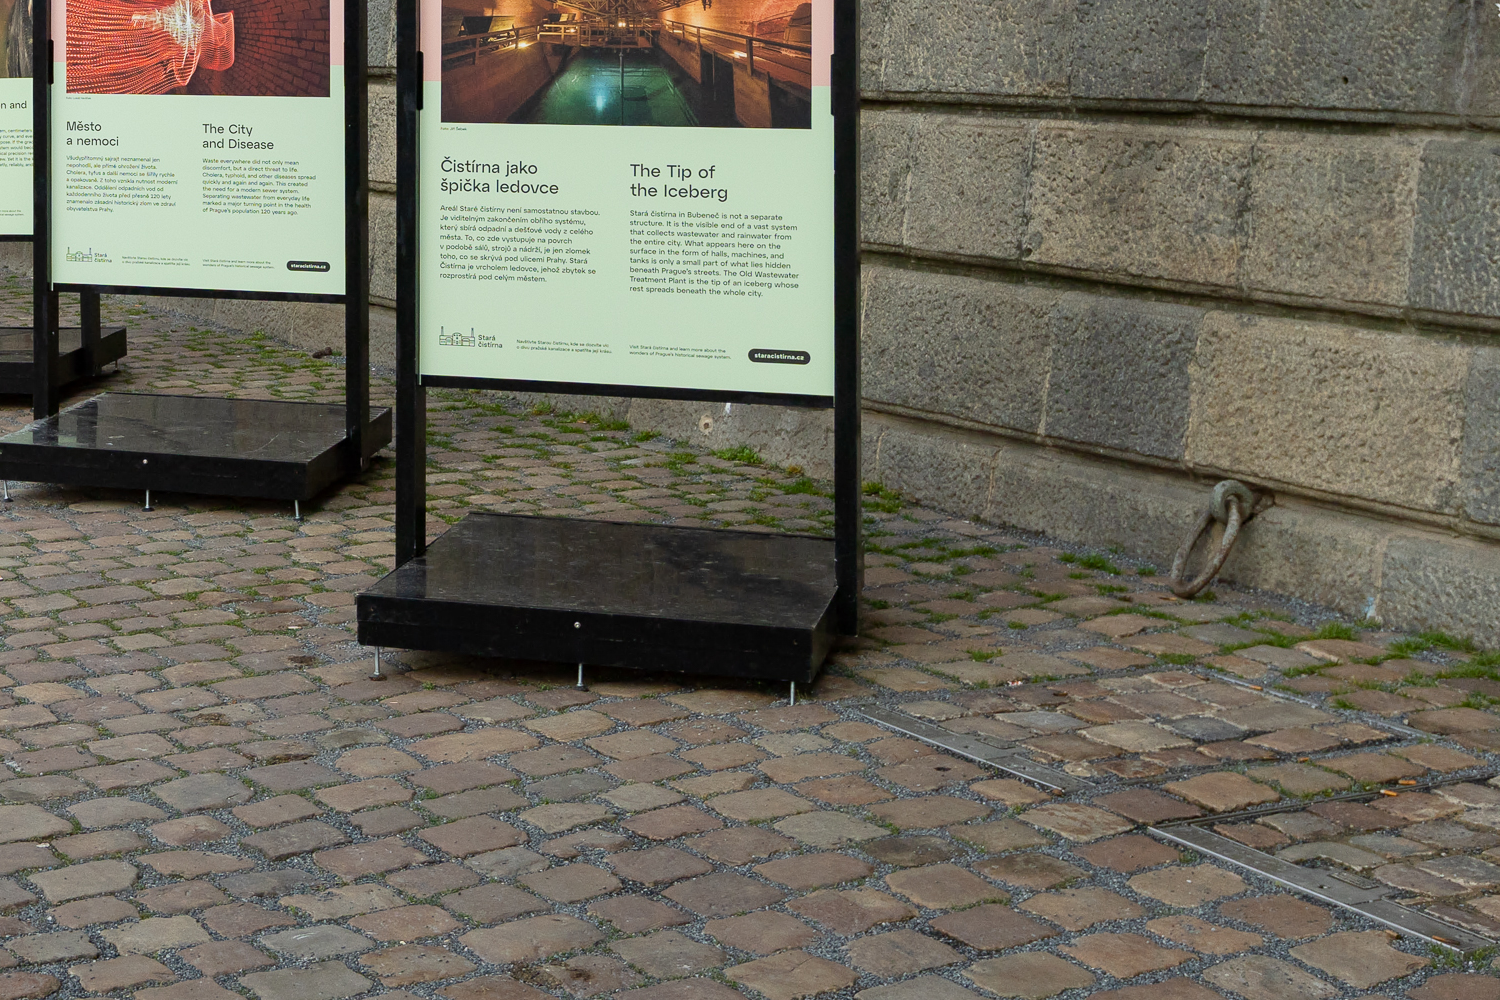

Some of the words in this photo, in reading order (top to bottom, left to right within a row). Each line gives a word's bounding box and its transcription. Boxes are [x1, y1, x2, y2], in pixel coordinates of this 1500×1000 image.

[10, 101, 27, 109] and
[67, 121, 101, 131] Město
[202, 124, 224, 134] The
[229, 124, 252, 137] City
[77, 136, 118, 146] nemoci
[203, 138, 224, 148] and
[229, 139, 274, 149] Disease
[441, 156, 500, 174] Čistírna
[506, 160, 537, 176] jako
[630, 164, 660, 177] The
[667, 165, 692, 181] Tip
[699, 165, 715, 178] of
[441, 178, 489, 194] špička
[496, 178, 559, 194] ledovce
[630, 183, 657, 197] the
[664, 184, 727, 202] Iceberg
[744, 280, 772, 289] iceberg
